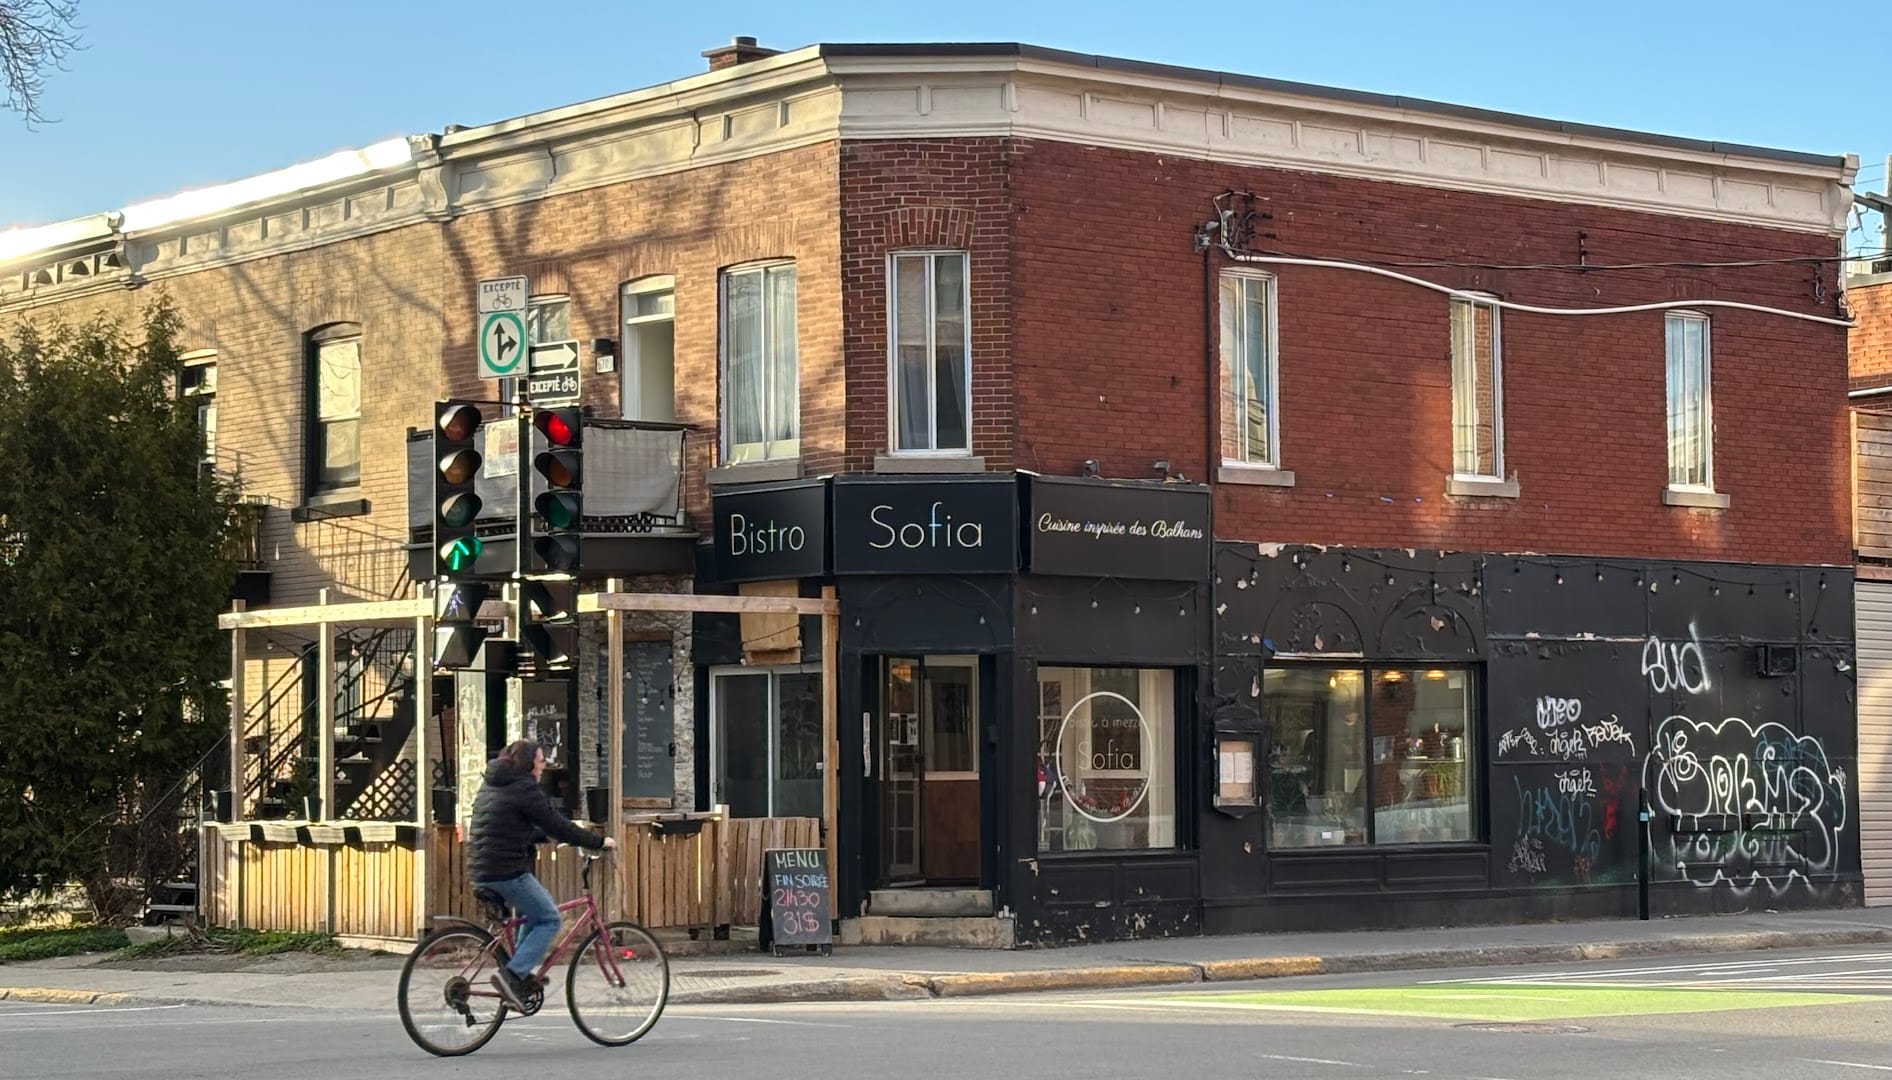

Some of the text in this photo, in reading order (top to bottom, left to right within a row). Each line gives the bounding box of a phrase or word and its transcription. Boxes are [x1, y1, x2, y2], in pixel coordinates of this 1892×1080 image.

[483, 280, 521, 293] EXCEPTÉ
[530, 375, 560, 394] EXCEPTÉ
[730, 513, 805, 556] Bistro
[868, 501, 983, 549] Sofia
[1038, 512, 1081, 533] Cuisine
[1129, 520, 1147, 536] des
[1078, 738, 1134, 770] Sofia
[775, 850, 820, 869] MENU
[775, 874, 794, 887] FIN
[774, 888, 820, 908] 21h30
[783, 909, 820, 935] 31$
